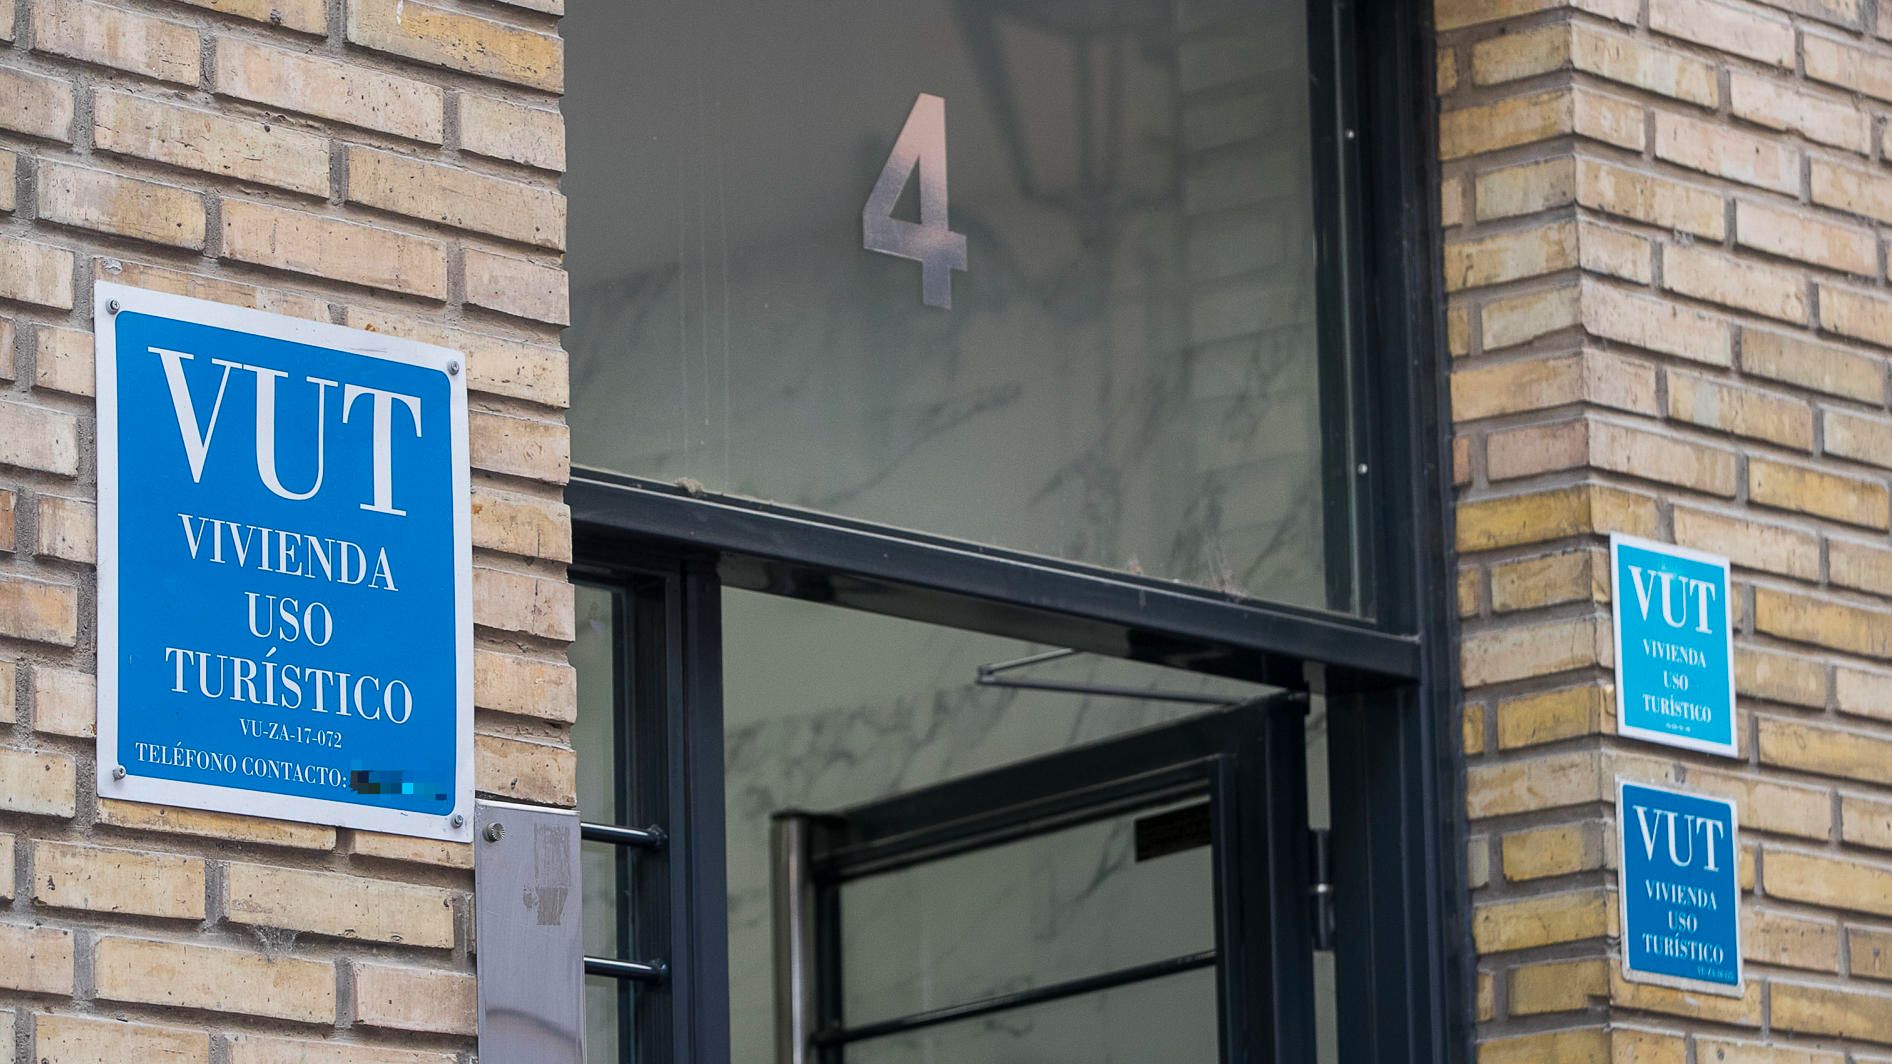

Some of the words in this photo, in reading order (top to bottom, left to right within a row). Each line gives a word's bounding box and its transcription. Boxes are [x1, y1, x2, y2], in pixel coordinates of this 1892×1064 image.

[863, 93, 967, 309] 4
[147, 346, 423, 517] VUT
[178, 513, 399, 592] VIVIENDA
[244, 592, 333, 647] USO
[1628, 564, 1716, 634] VUT
[1643, 638, 1707, 668] VIVIENDA
[165, 646, 413, 724] TURÍSTICO
[1663, 670, 1689, 691] USO
[1643, 693, 1712, 724] TURÍSTICO
[240, 718, 342, 748] VU-ZA-17-072
[135, 741, 236, 774] TELÉFONO
[241, 756, 347, 788] CONTACTO:
[1632, 805, 1724, 872] VUT
[1645, 879, 1717, 911] VIVIENDA
[1668, 910, 1698, 933] USO
[1642, 931, 1724, 965] TURÍSTICO
